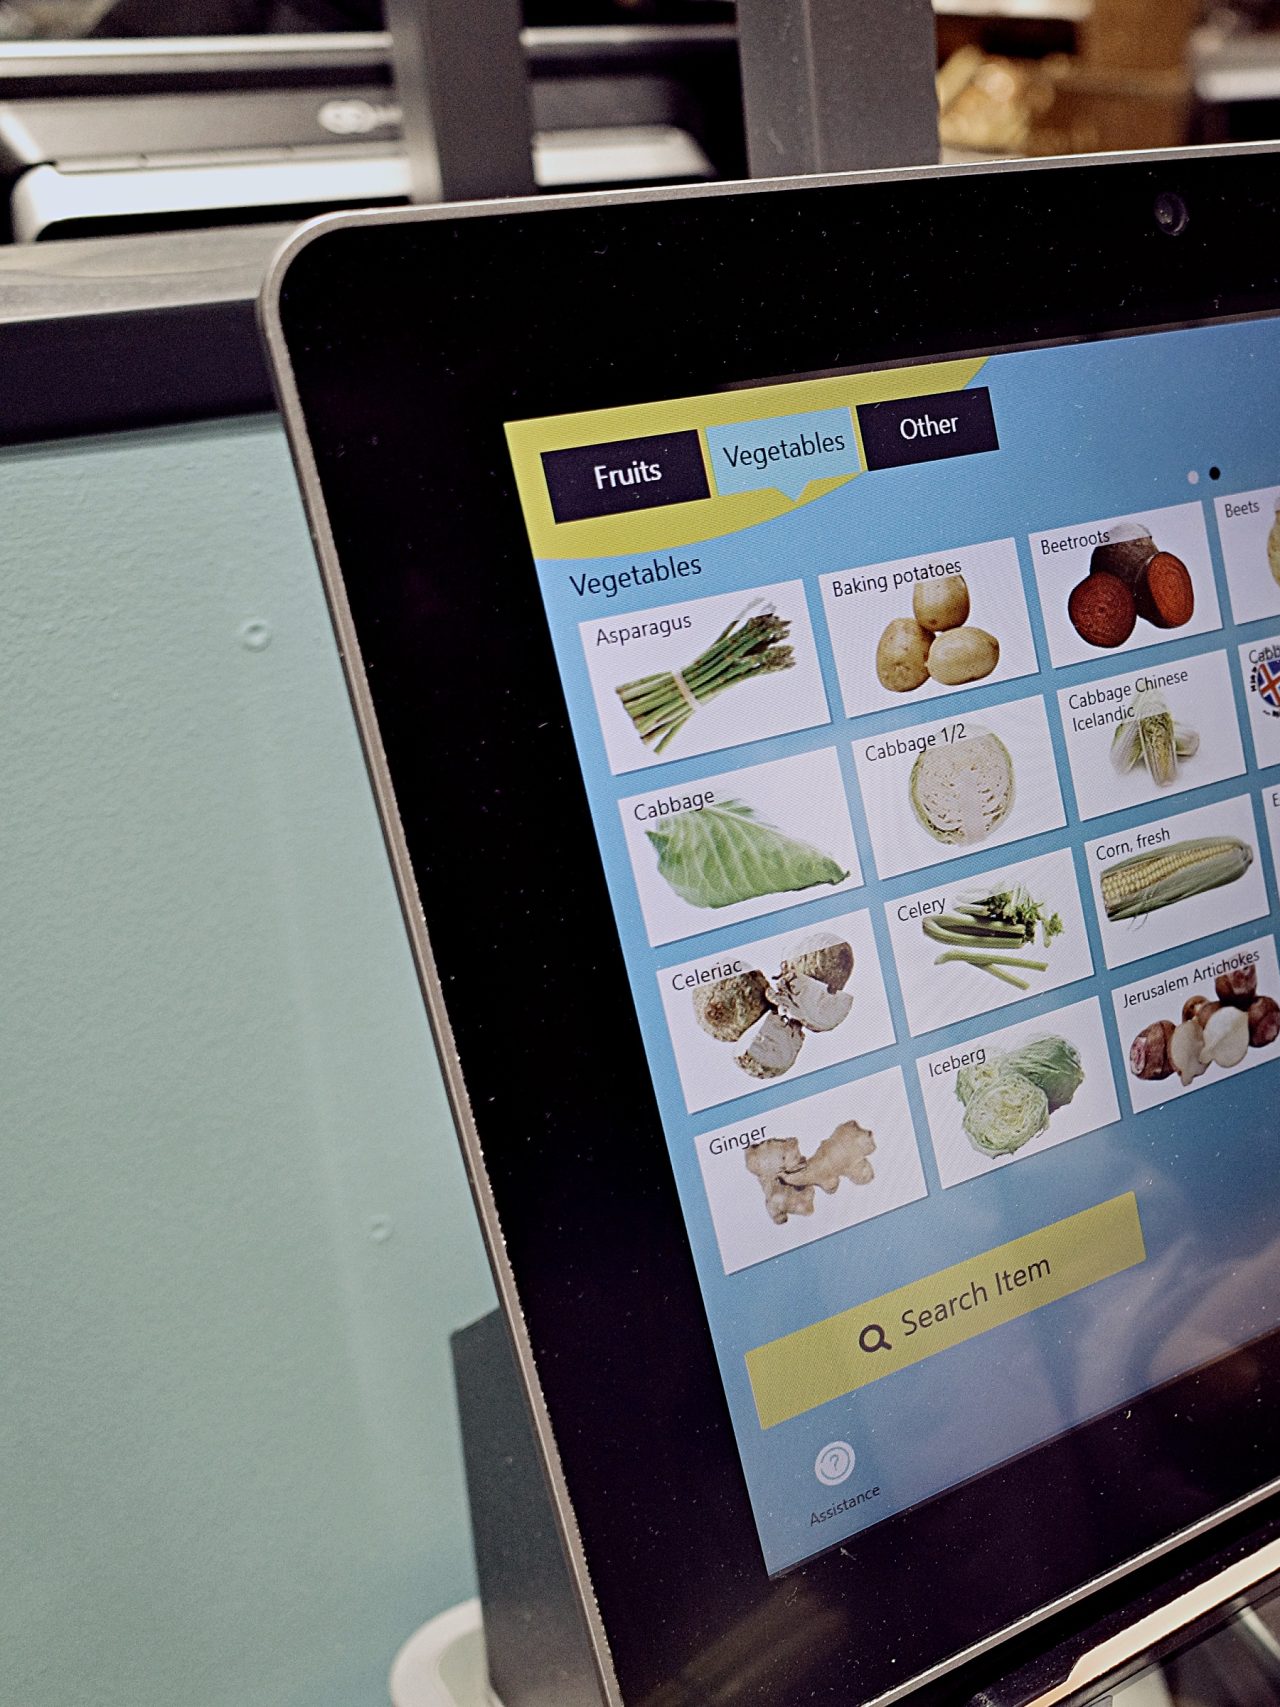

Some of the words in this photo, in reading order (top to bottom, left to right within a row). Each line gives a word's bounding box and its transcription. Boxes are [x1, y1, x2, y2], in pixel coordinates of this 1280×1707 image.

[899, 414, 959, 441] Other
[722, 432, 846, 470] Vegetables
[593, 461, 662, 490] Fruits
[1224, 499, 1260, 519] Beets
[1040, 529, 1110, 556] Beetroots
[569, 555, 702, 599] Vegetables
[832, 574, 889, 598] Baking
[893, 559, 962, 591] potatoes
[595, 613, 692, 647] Asparagus
[1068, 683, 1132, 711] Cabbage
[1135, 669, 1189, 694] Chinese
[1072, 705, 1135, 732] Icelandic
[865, 732, 937, 763] Cabbage
[941, 722, 967, 746] 1/2
[633, 789, 716, 822] Cabbage
[1096, 838, 1133, 861] Corn,
[1136, 827, 1171, 849] fresh
[897, 895, 947, 922] Celery
[672, 959, 743, 992] Celeriac
[1123, 975, 1189, 1009] Jerusalem
[1193, 950, 1260, 984] Artichokes
[929, 1046, 986, 1078] Iceberg
[708, 1123, 768, 1157] Ginger
[900, 1281, 989, 1337] Search
[995, 1257, 1051, 1296] Item
[809, 1484, 881, 1527] Assistance
